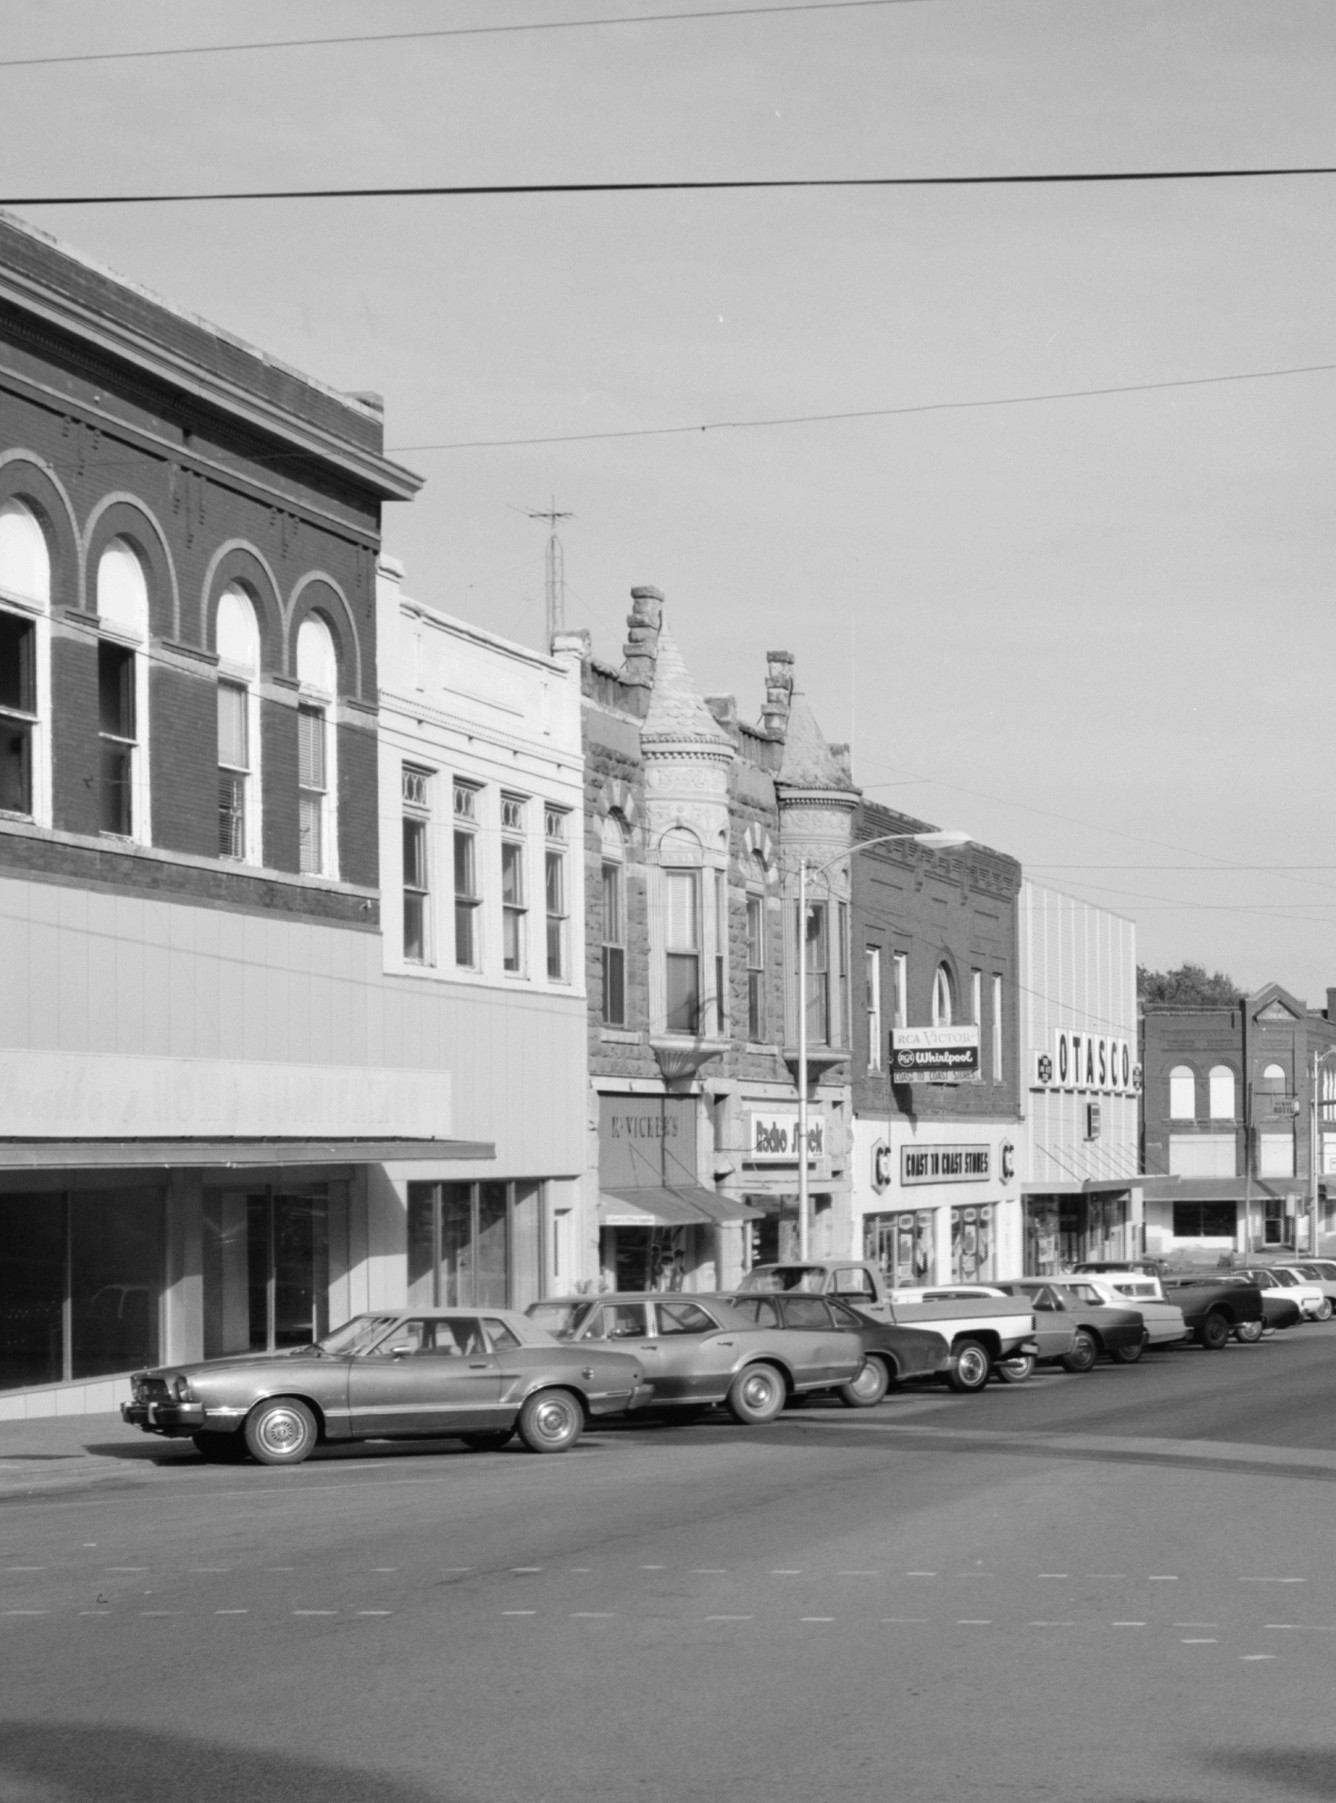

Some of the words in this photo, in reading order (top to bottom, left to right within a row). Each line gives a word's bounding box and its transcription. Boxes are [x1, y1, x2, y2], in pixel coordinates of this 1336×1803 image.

[897, 1033, 920, 1044] RCA
[922, 1031, 969, 1046] VICTOR
[916, 1050, 973, 1066] Whirlpool
[1059, 1033, 1129, 1087] OTASCO
[756, 1120, 788, 1153] Radio
[906, 1153, 929, 1177] COAST
[931, 1153, 939, 1175] TO
[942, 1152, 963, 1175] COAST
[965, 1152, 988, 1173] STORES
